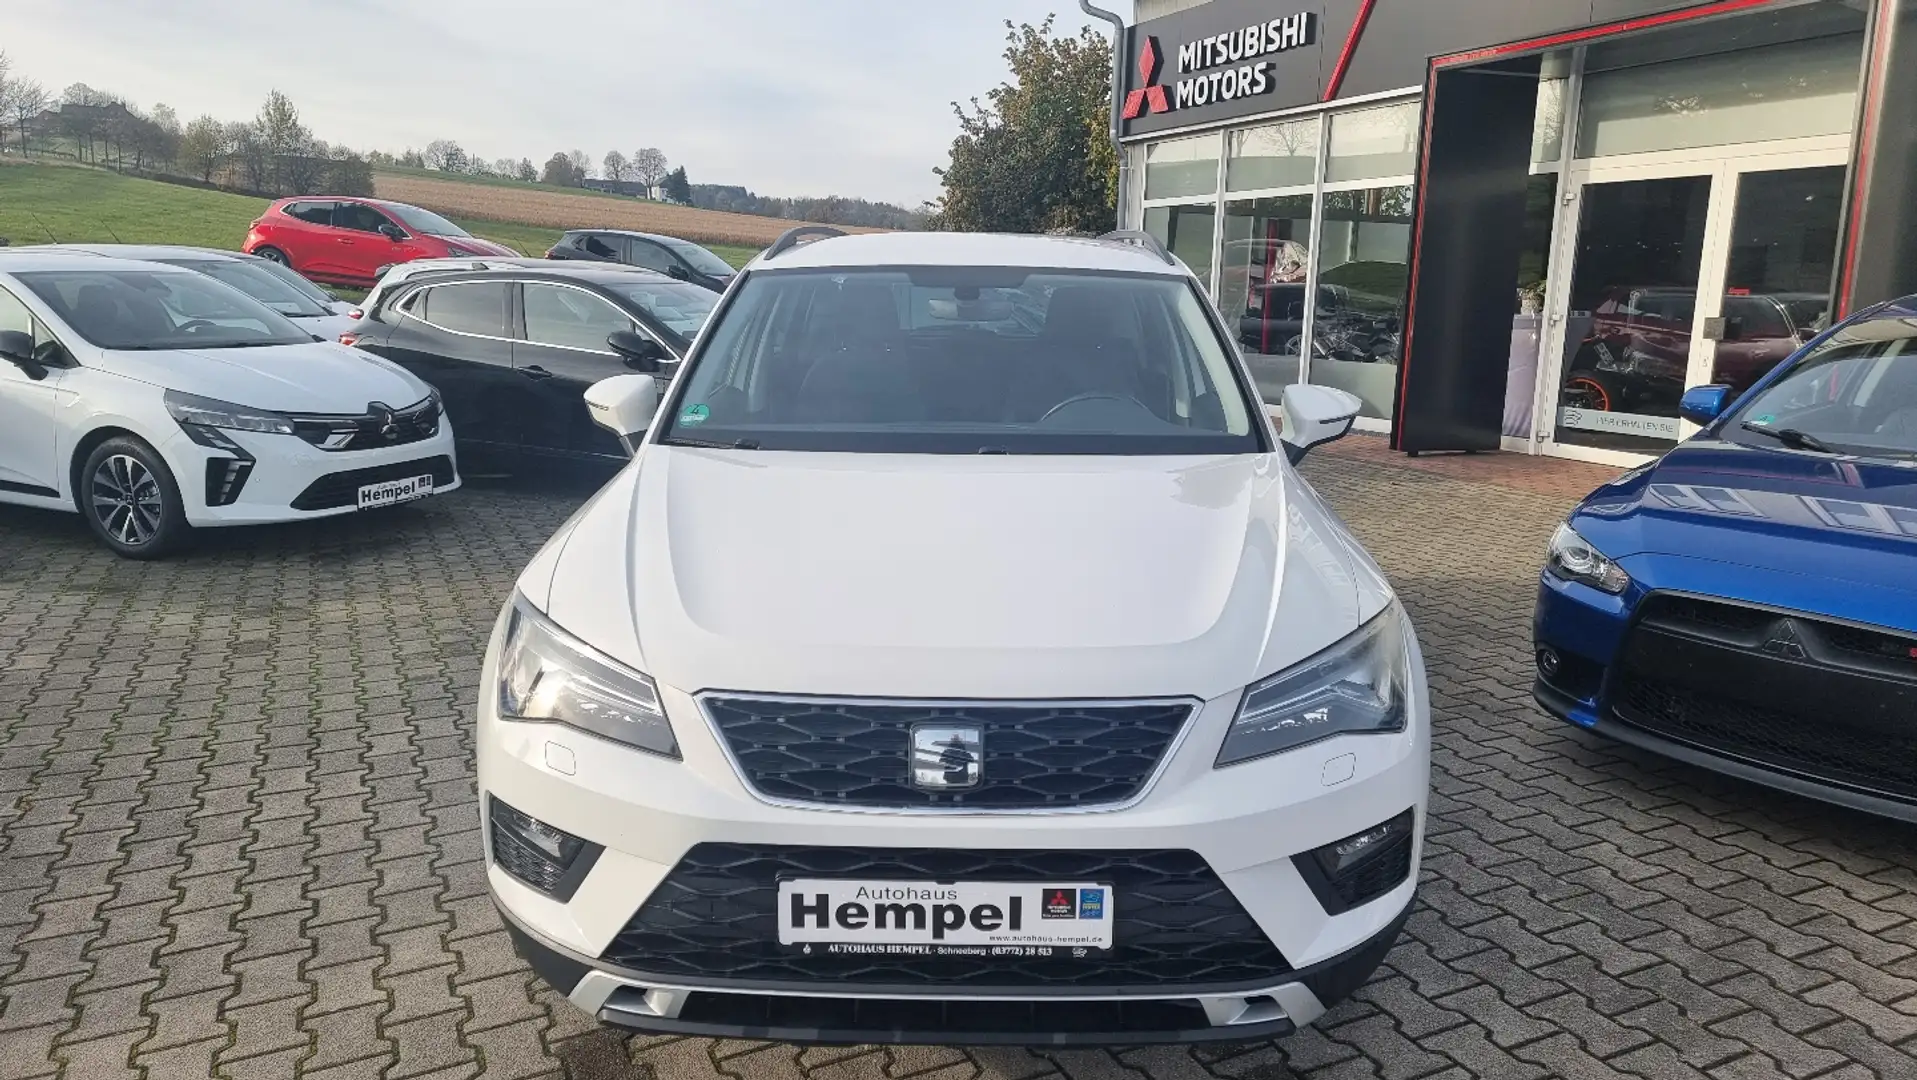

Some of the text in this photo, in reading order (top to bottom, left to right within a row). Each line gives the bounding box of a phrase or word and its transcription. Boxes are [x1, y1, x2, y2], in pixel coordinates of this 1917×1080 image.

[1178, 12, 1308, 73] MITSUBISHI
[1176, 62, 1268, 109] MOTORS
[361, 481, 415, 503] Hempel
[856, 886, 957, 900] Autohaus
[791, 893, 1022, 940] Hempel
[828, 944, 884, 954] AUTOHAUS
[886, 945, 931, 955] HEMPEL
[937, 946, 986, 956] Schneeberg
[1025, 948, 1036, 956] 28
[989, 935, 1103, 944] www.autohaus-hempel.de
